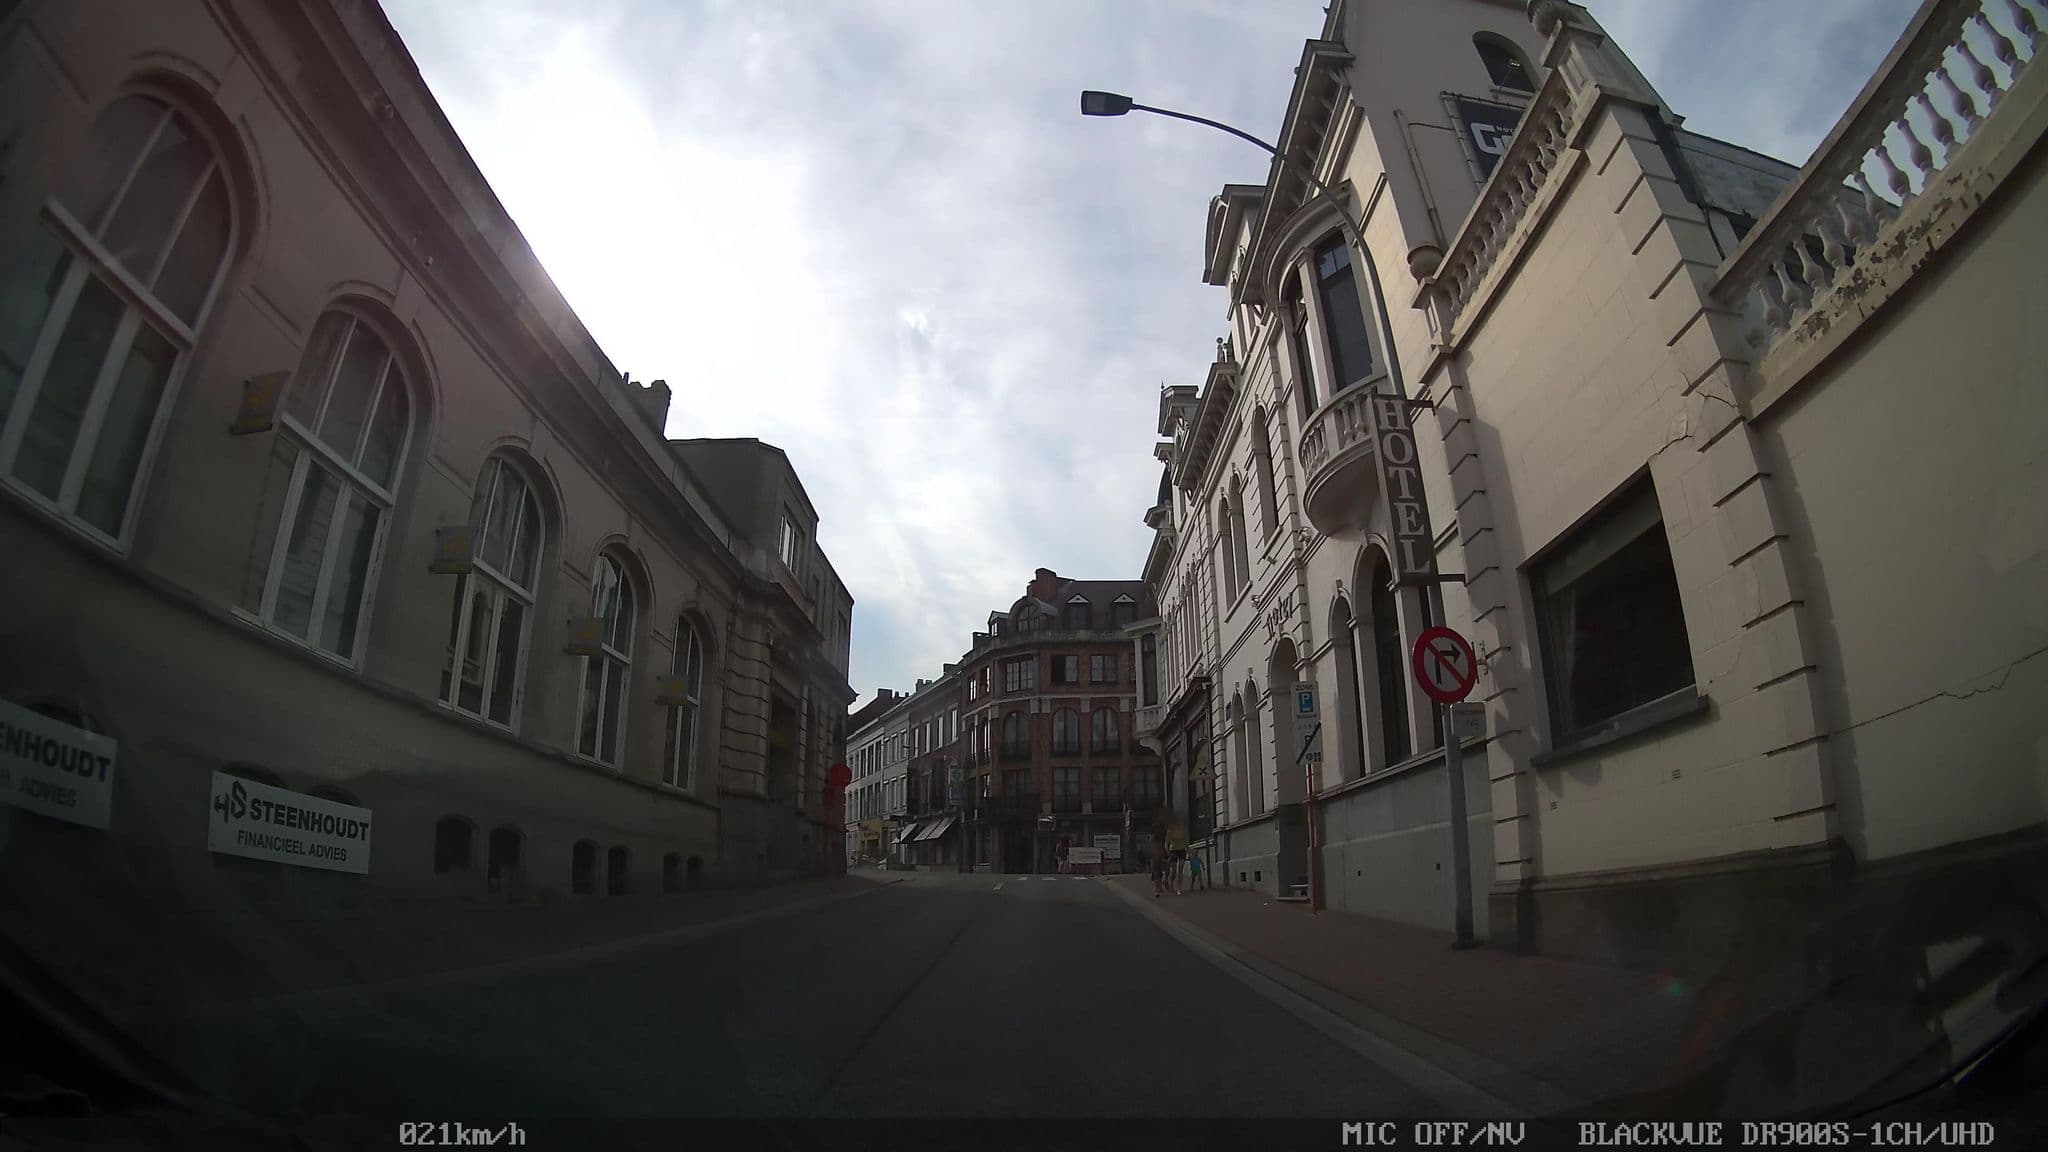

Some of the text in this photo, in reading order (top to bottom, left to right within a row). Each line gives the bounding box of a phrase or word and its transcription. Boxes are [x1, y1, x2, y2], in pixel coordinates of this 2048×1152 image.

[1376, 399, 1430, 574] HOTEL
[249, 798, 369, 841] STEENHOUDT
[238, 829, 347, 862] FINANCIEEL ADVIES
